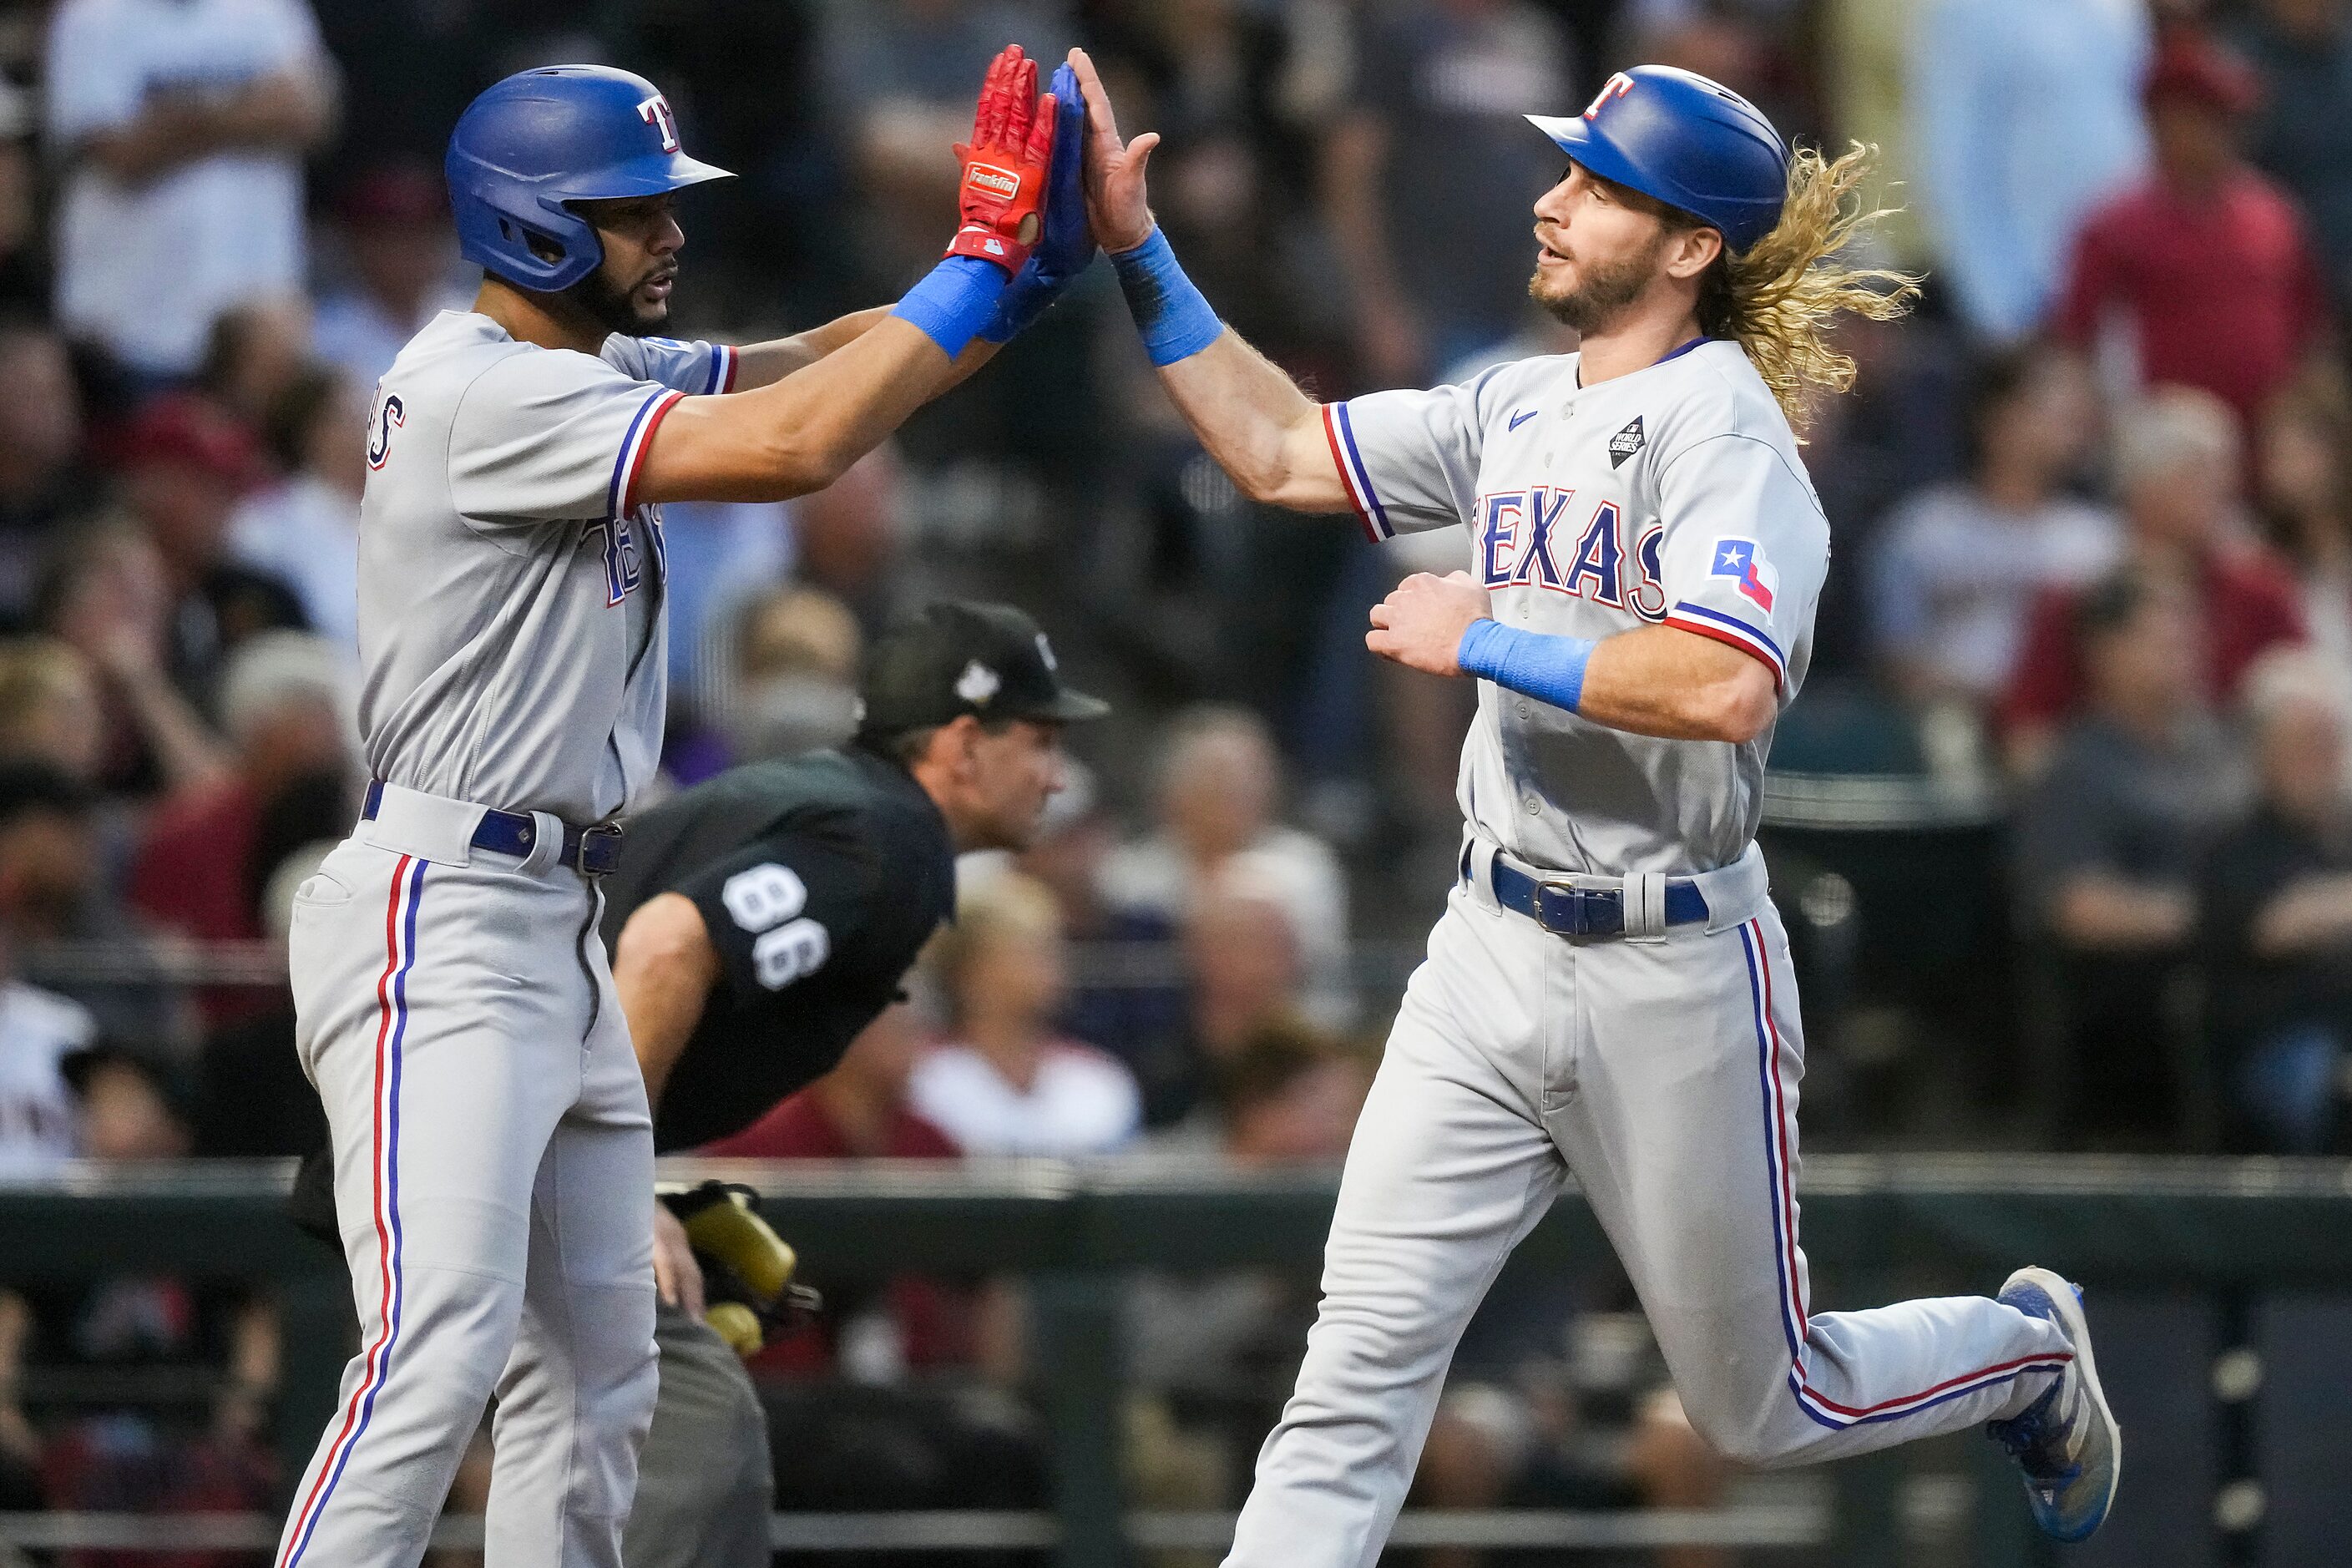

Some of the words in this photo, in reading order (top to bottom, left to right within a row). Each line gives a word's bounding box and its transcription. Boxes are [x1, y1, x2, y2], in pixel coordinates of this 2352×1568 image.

[1583, 72, 1636, 121] T
[636, 94, 679, 154] T
[969, 166, 1016, 193] Franklin
[1609, 441, 1638, 453] SERIES
[1615, 432, 1642, 443] WORLD
[1472, 485, 1668, 624] EXAS
